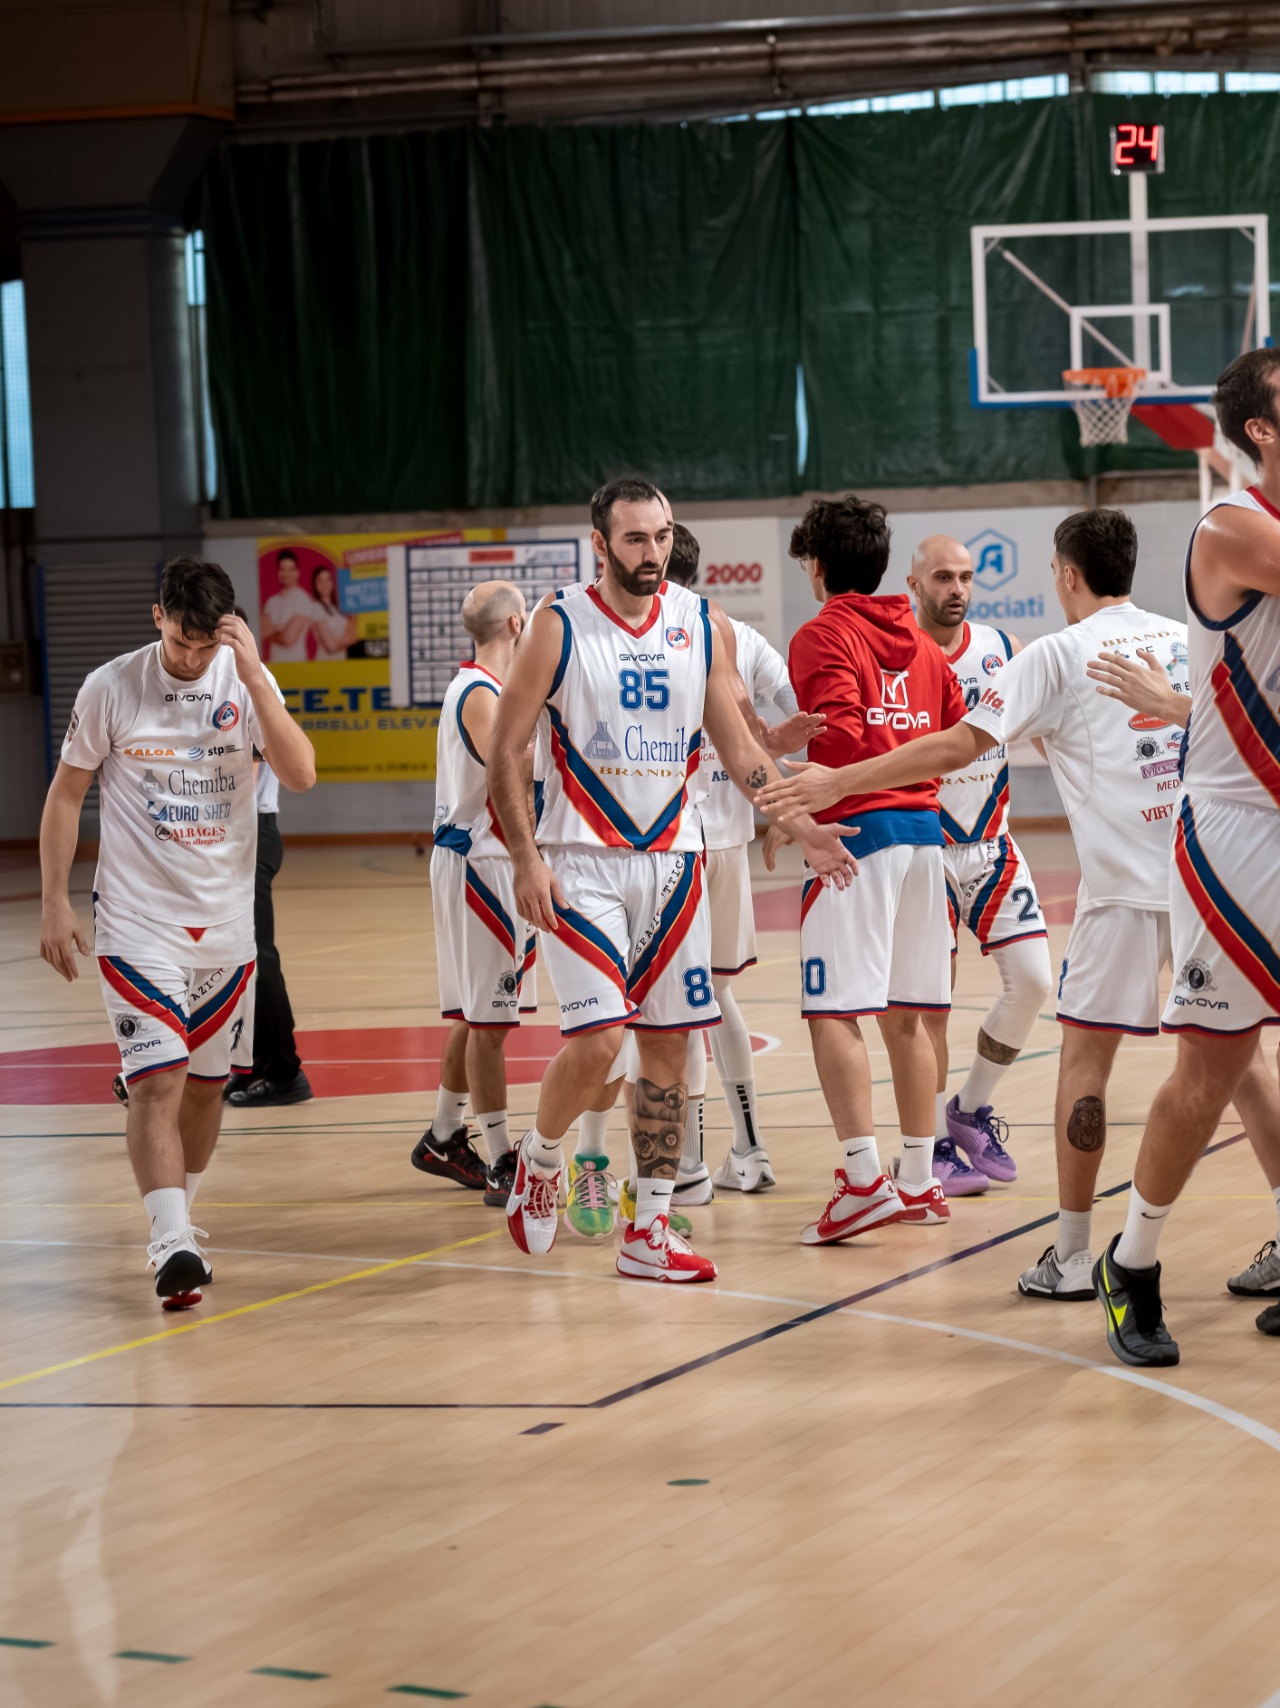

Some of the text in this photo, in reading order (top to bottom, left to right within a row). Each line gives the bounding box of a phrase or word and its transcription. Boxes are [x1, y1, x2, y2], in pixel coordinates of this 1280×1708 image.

[1115, 124, 1159, 164] 24
[704, 563, 763, 586] 2000
[964, 594, 1045, 620] sociati
[619, 653, 666, 662] GIVOVA
[165, 693, 212, 702] GIVOVA
[618, 667, 671, 712] 85
[123, 748, 175, 757] KALOA
[207, 745, 225, 757] stp
[625, 725, 688, 763] Chemib
[168, 766, 236, 796] Chemiba
[600, 766, 686, 778] BRANDA
[168, 802, 232, 822] EURO SHED
[1010, 886, 1041, 923] 2
[682, 965, 713, 1010] 8
[1174, 995, 1229, 1010] GIVOVA
